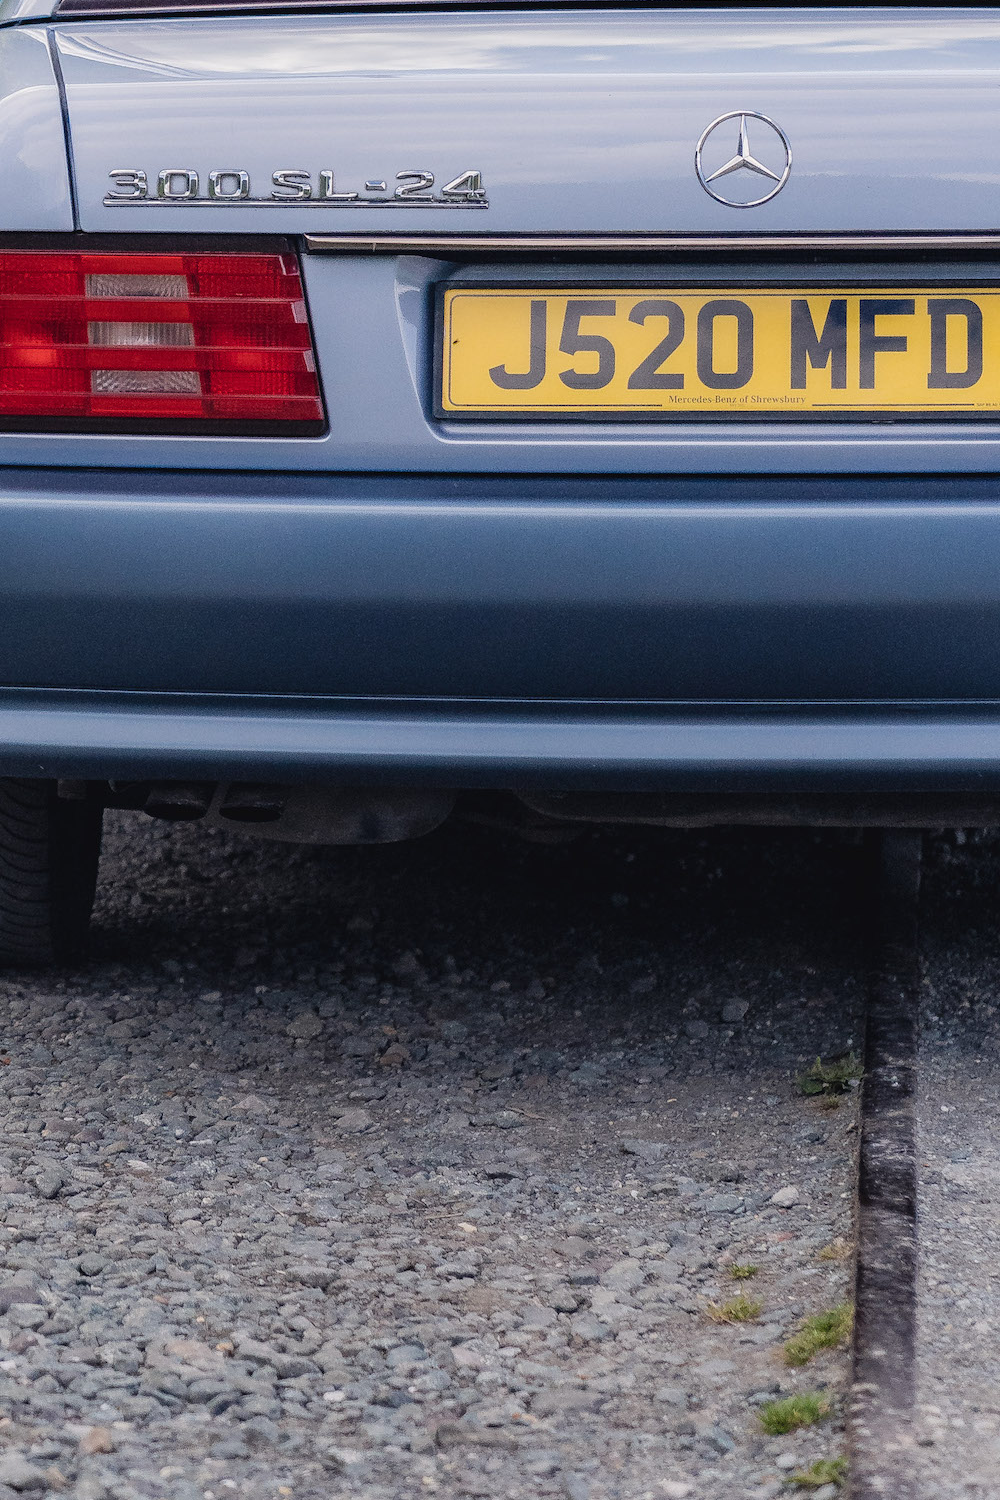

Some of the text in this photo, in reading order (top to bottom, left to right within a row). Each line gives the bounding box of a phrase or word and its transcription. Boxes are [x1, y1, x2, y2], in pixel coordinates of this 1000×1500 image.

[107, 168, 250, 200] 300
[488, 299, 984, 390] J520 MFD
[668, 395, 737, 404] Mercedes-Benz
[739, 395, 749, 404] of
[751, 395, 806, 405] Shrewsbury
